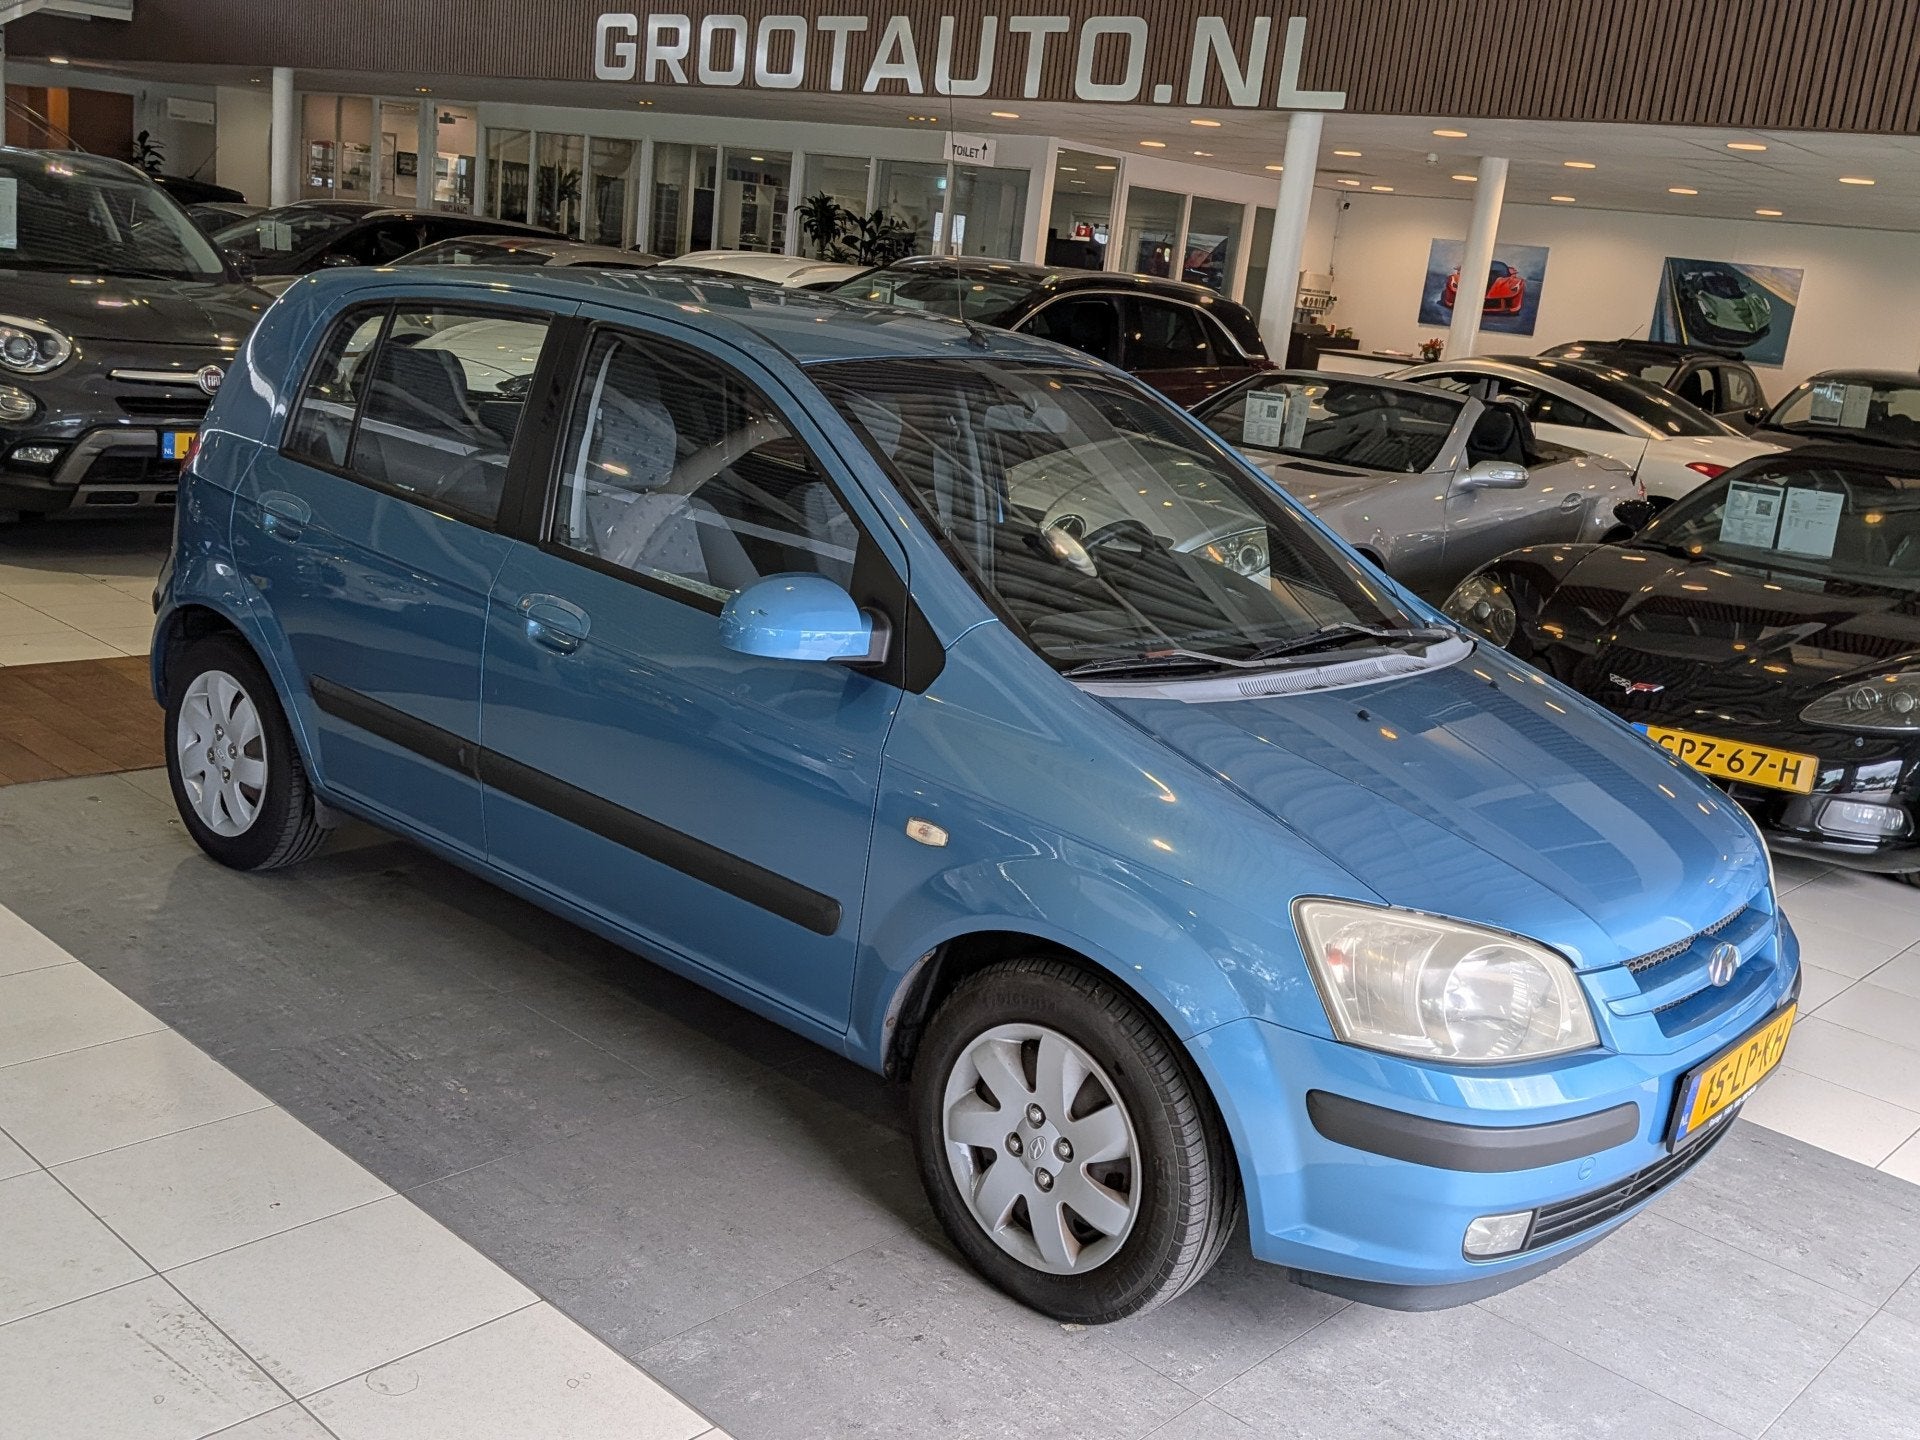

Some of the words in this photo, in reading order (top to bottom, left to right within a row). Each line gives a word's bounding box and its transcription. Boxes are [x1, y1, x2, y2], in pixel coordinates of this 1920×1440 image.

[595, 13, 1347, 110] GROOTAUTO.NL
[952, 144, 980, 159] TOILET
[207, 375, 221, 387] FIAT
[1702, 1018, 1789, 1115] 15-LP-KH
